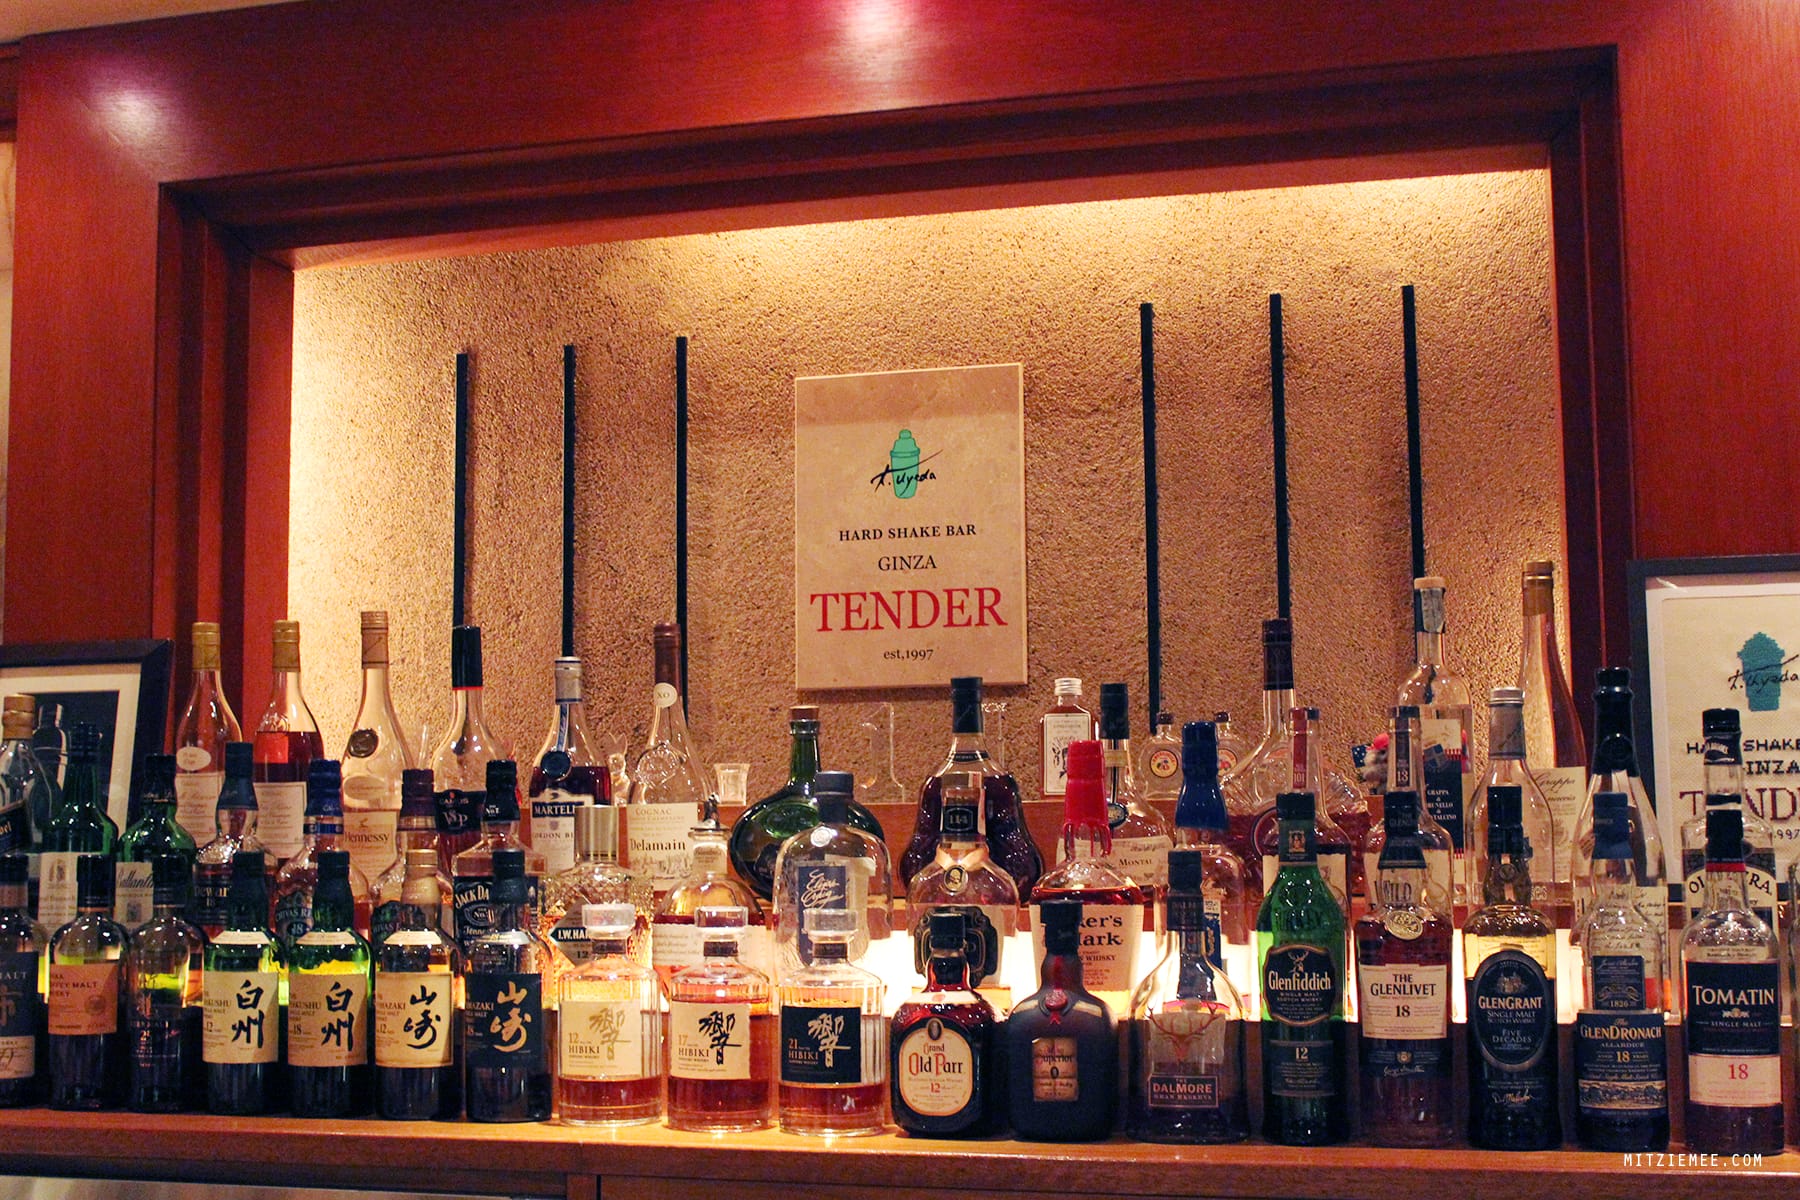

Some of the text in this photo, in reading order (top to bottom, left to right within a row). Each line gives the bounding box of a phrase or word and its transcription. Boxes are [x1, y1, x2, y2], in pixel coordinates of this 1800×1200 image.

[839, 524, 976, 541] HARD SHAKE BAR
[878, 555, 937, 571] GINZA
[810, 587, 1008, 632] TENDER
[1743, 760, 1800, 775] INZA
[630, 838, 686, 851] Delamain
[455, 889, 476, 909] JACK
[1268, 970, 1331, 991] Glenfiddich
[1392, 973, 1413, 983] THE
[1370, 983, 1437, 997] GLENLIVET
[1692, 985, 1775, 1006] TOMATIN
[231, 979, 265, 1049] 白州
[321, 981, 355, 1052] 白州
[403, 985, 441, 1049] 山崎
[490, 981, 532, 1053] 山崎
[1395, 1004, 1411, 1018] 18
[1487, 1010, 1536, 1018] SINGLE MALT
[568, 1032, 579, 1044] 12
[589, 1007, 632, 1061] 響
[678, 1034, 688, 1046] 17
[698, 1010, 742, 1066] 響
[807, 1012, 852, 1069] 響
[1580, 1025, 1662, 1041] GLENDRONACH
[568, 1045, 600, 1054] HIBIKI
[788, 1038, 798, 1049] 21
[923, 1043, 945, 1055] Grand
[678, 1047, 710, 1057] HIBIKI
[788, 1050, 819, 1060] HIBIKI
[1295, 1047, 1308, 1060] 12
[1616, 1051, 1631, 1063] 18
[908, 1052, 964, 1077] Old Parr
[1728, 1064, 1749, 1080] 18
[930, 1082, 941, 1093] 12
[1152, 1083, 1212, 1094] DALMORE
